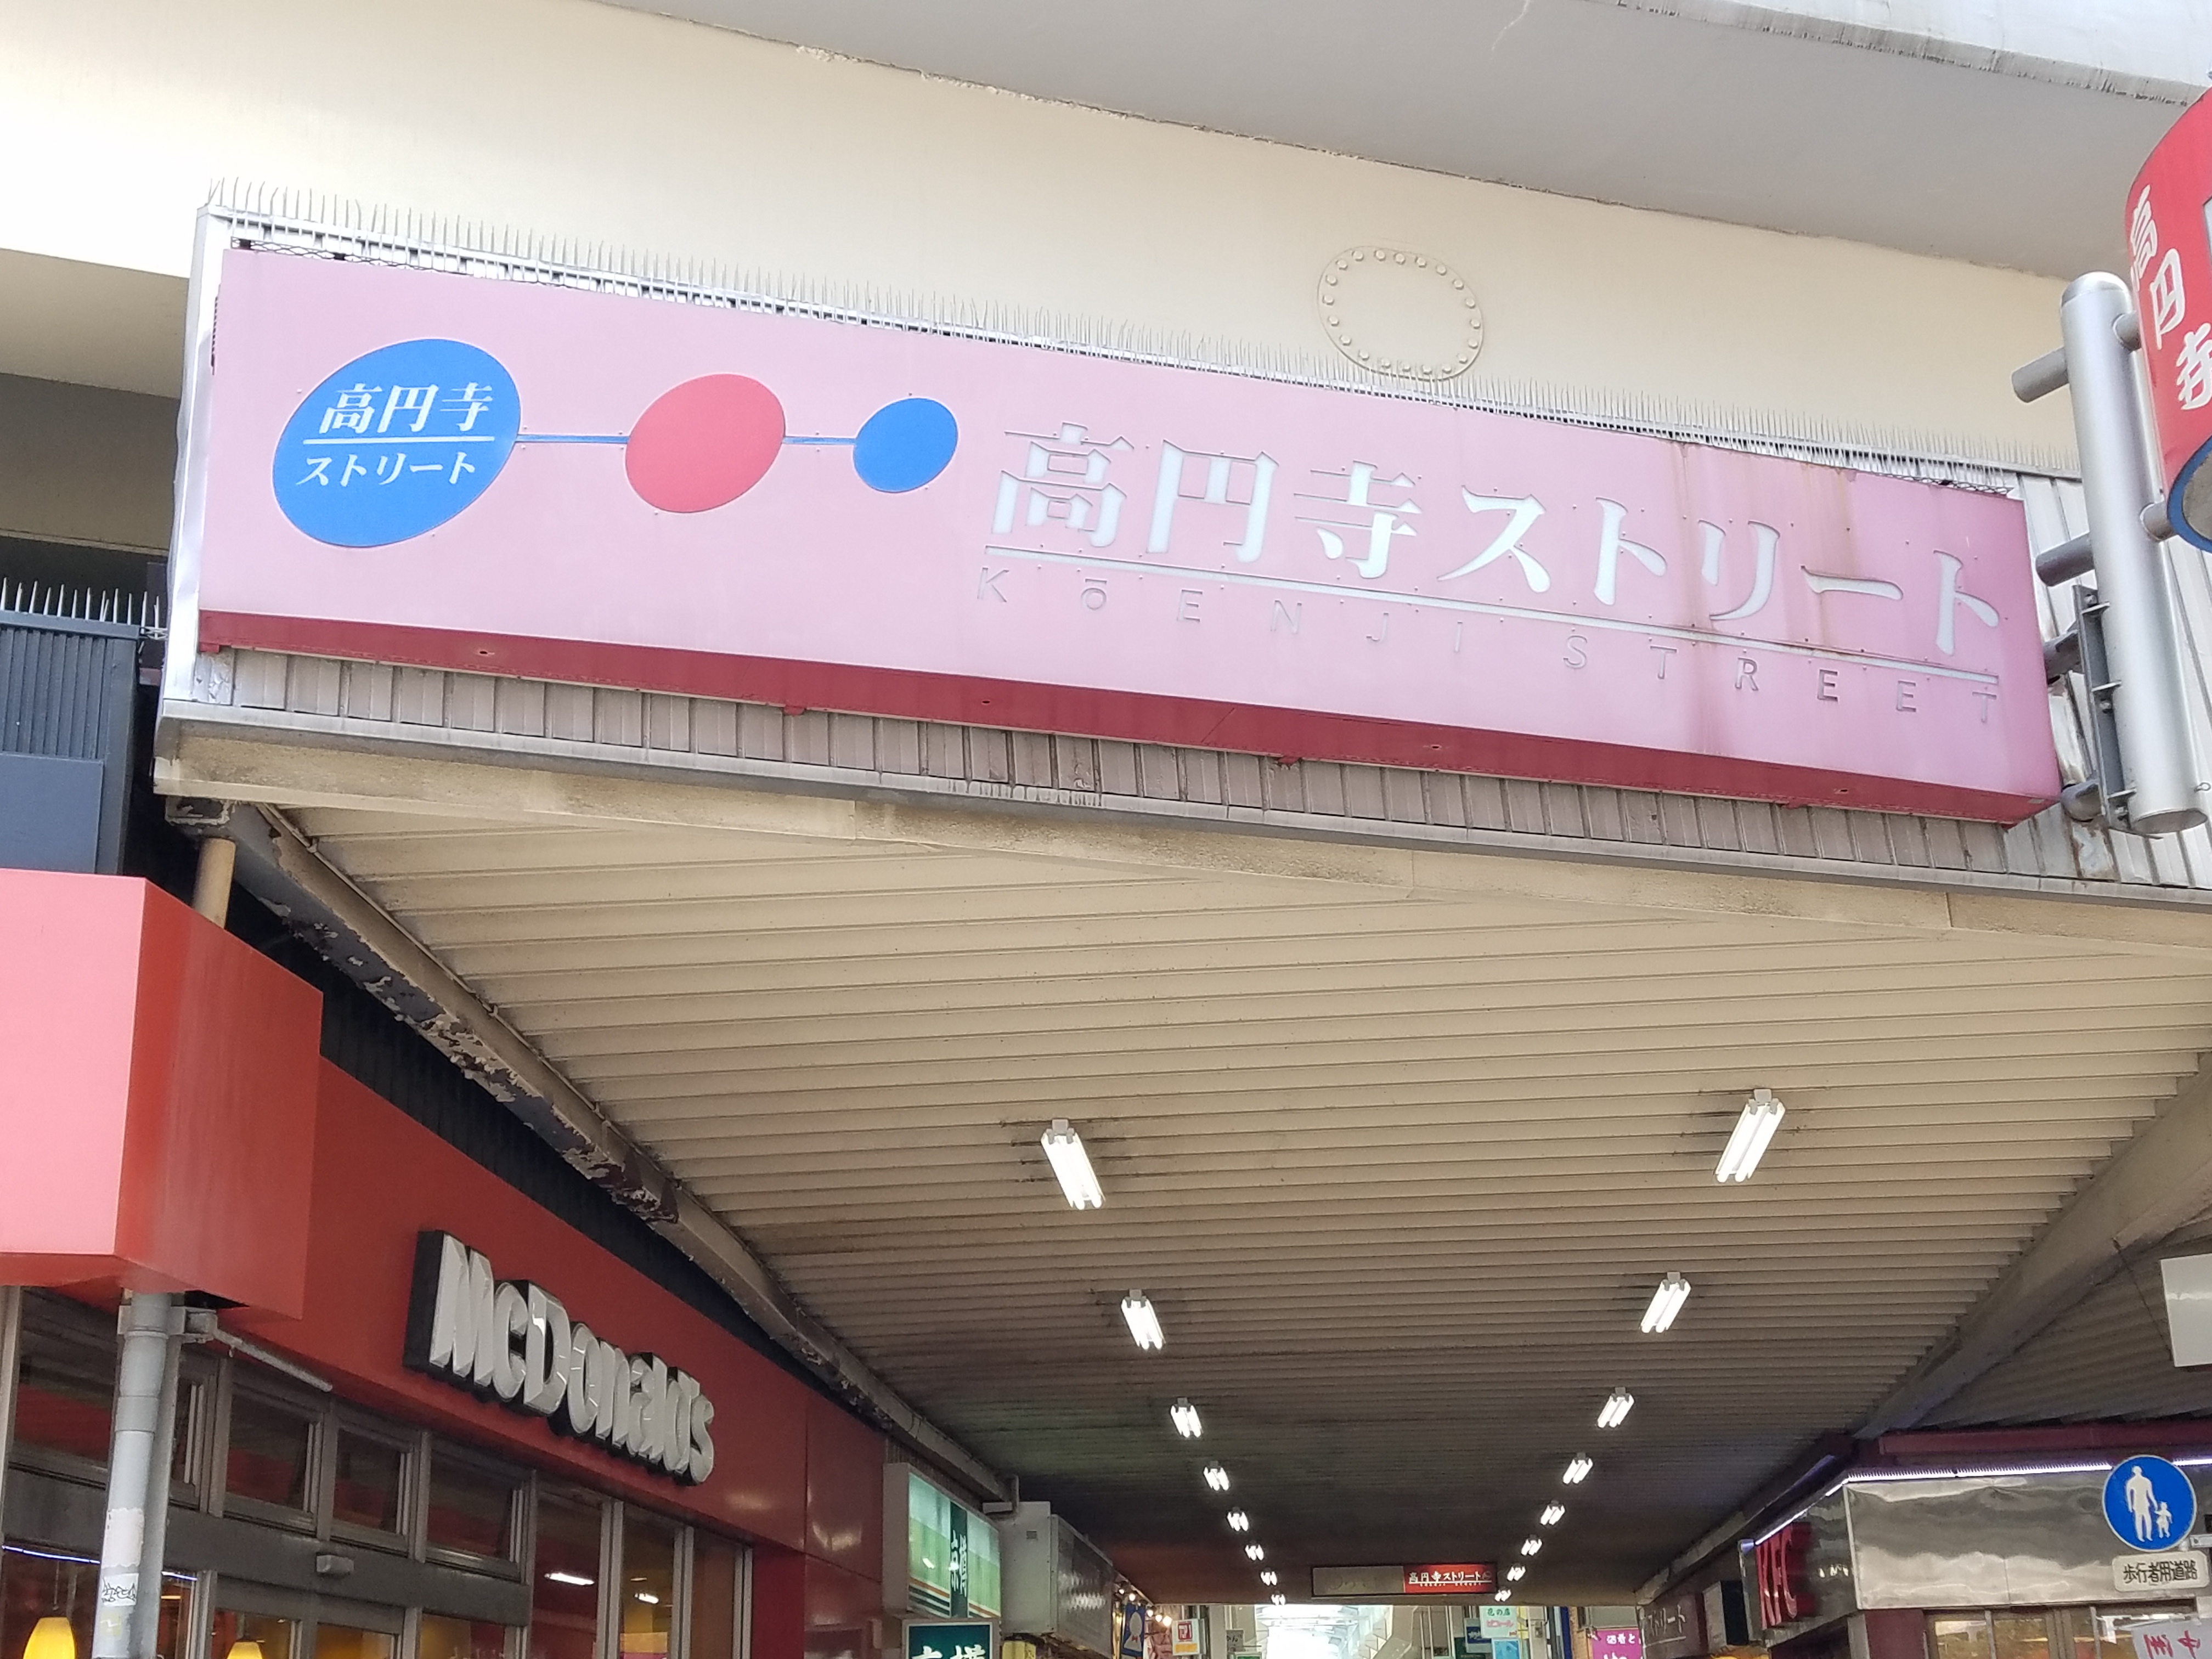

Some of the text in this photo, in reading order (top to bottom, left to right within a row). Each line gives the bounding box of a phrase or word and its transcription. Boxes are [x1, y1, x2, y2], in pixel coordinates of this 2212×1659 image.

[319, 382, 493, 434] 高円寺
[296, 452, 476, 487] ストリート
[991, 421, 2000, 656] 高円寺ストリート
[1563, 634, 1997, 723] STREET
[429, 1233, 714, 1483] McDonald's
[1409, 1571, 1481, 1582] 高円寺ストリート
[2123, 1559, 2198, 1584] 歩行者用道路
